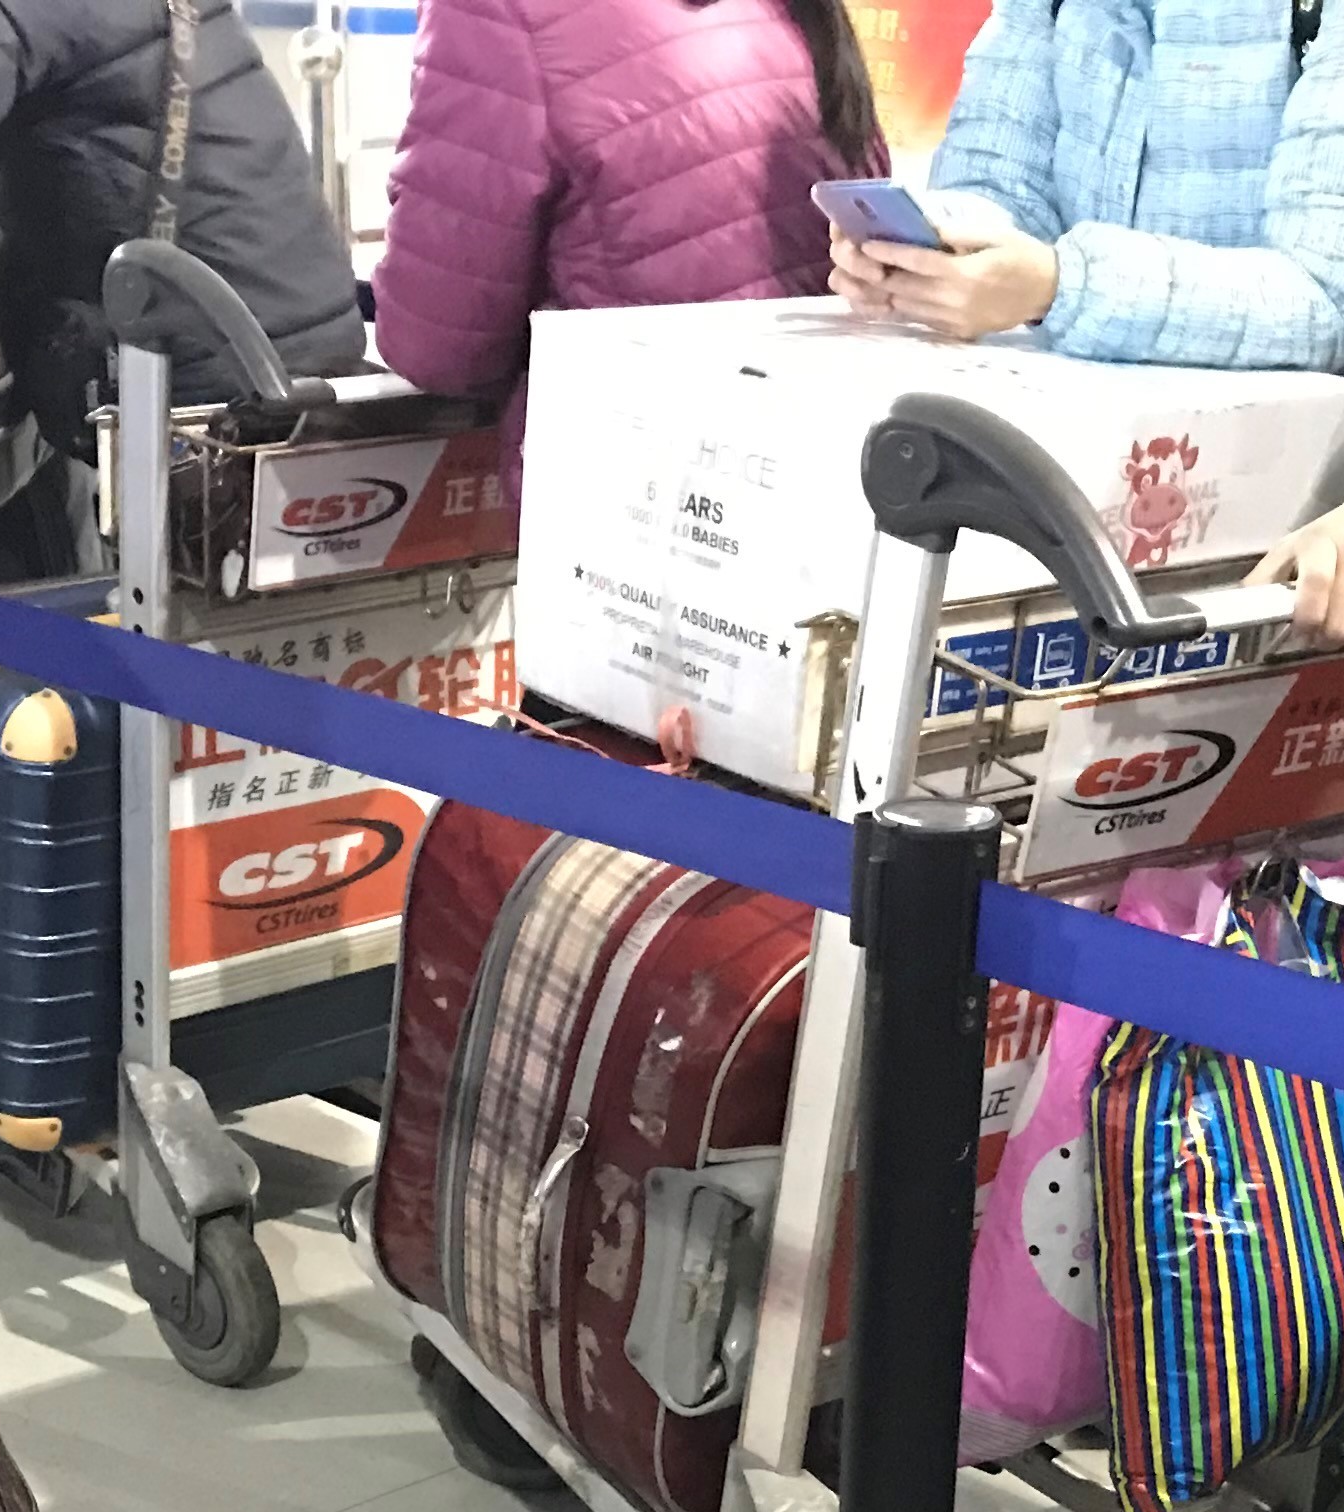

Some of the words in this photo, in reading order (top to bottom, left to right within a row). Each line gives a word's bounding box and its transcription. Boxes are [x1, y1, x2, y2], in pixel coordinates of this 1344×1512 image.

[160, 72, 191, 181] COMELY
[280, 491, 378, 526] CST
[304, 537, 361, 556] CSTtires
[692, 526, 739, 556] BABIES
[680, 606, 769, 651] ASSURANCE
[632, 642, 653, 661] AIR
[207, 765, 334, 811] 指名正新
[1075, 747, 1202, 796] CST
[1094, 807, 1167, 836] CSTtires
[219, 832, 364, 897] CST
[256, 902, 339, 934] CSTtires
